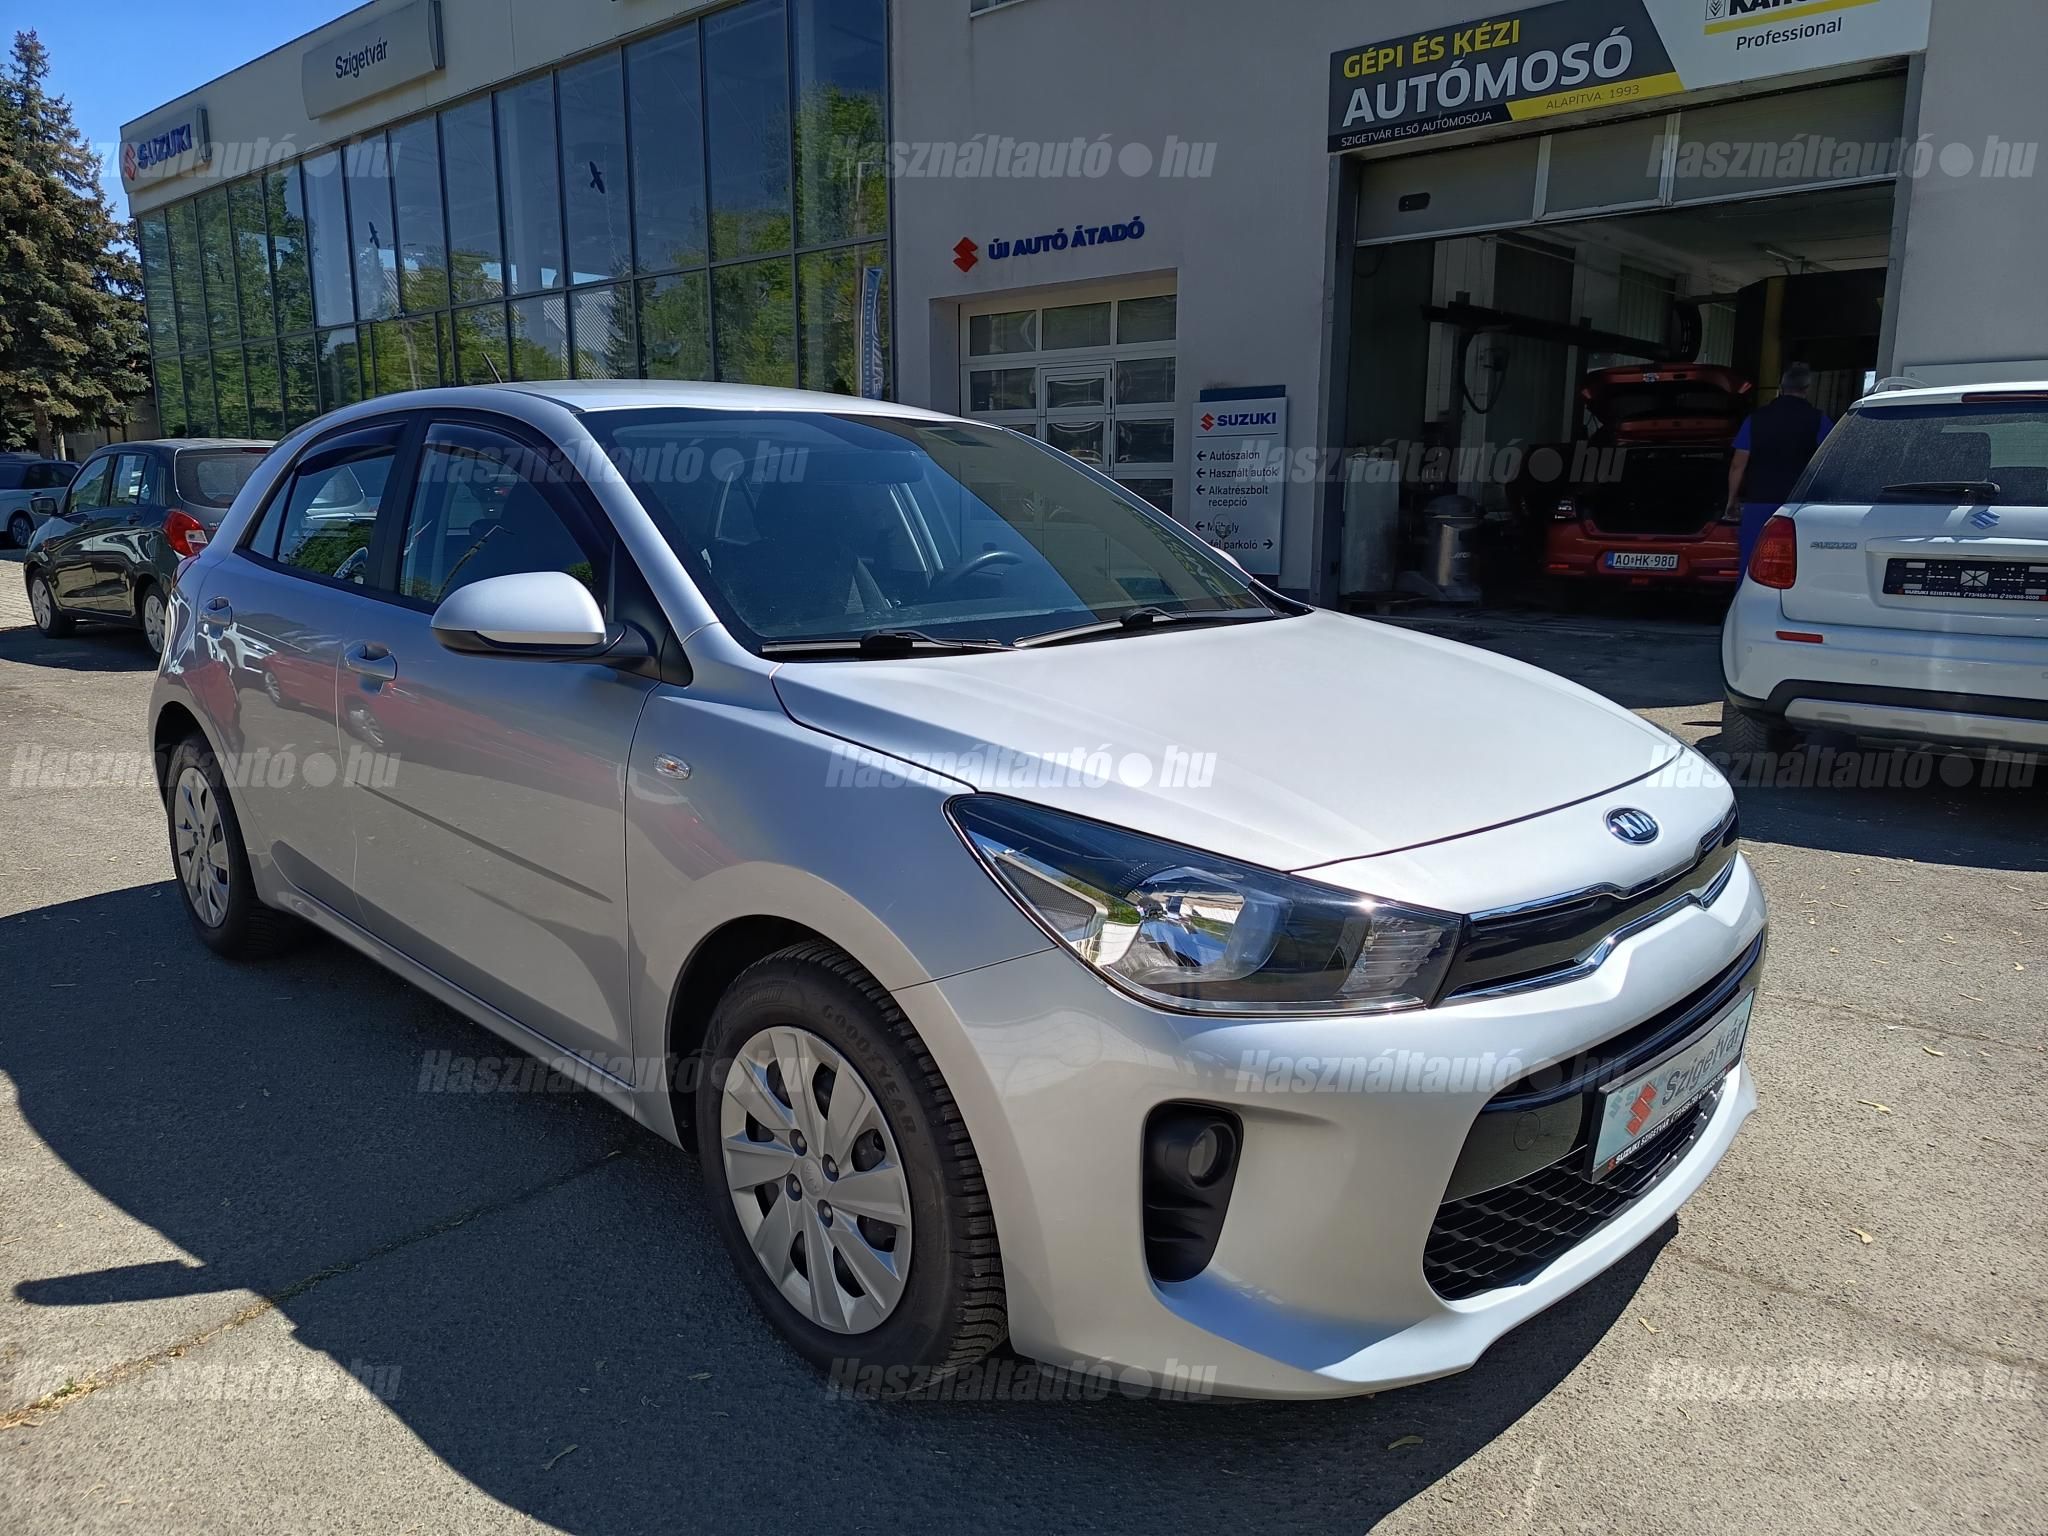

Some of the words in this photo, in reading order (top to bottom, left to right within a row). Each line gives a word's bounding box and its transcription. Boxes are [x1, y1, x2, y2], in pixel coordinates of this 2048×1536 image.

[1343, 44, 1403, 79] GÉPI
[1411, 35, 1445, 65] ÉS
[1453, 19, 1520, 57] KÉZI
[1736, 17, 1843, 51] Professional
[335, 37, 388, 78] Szigetvár
[1342, 26, 1633, 127] AUTÓMOSÓ
[1610, 84, 1640, 99] 1993
[1341, 128, 1392, 147] SZIGETVÁR
[1395, 122, 1419, 137] ELSŐ
[1422, 111, 1493, 132] AUTÓMOSÓJA
[137, 123, 192, 169] SUZUKI
[1012, 228, 1068, 257] AUTÓ
[1071, 215, 1145, 248] ÁTADÓ
[1217, 412, 1277, 427] SUZUKI
[1209, 450, 1260, 461] Autószalon
[1209, 467, 1248, 478] Használt
[1250, 467, 1278, 478] autók
[1208, 484, 1269, 496] Alkatrészbolt
[1208, 497, 1248, 508] recepció
[1224, 539, 1258, 551] parkoló
[1611, 811, 1657, 838] KIA
[1662, 1016, 1745, 1106] Szigetvár
